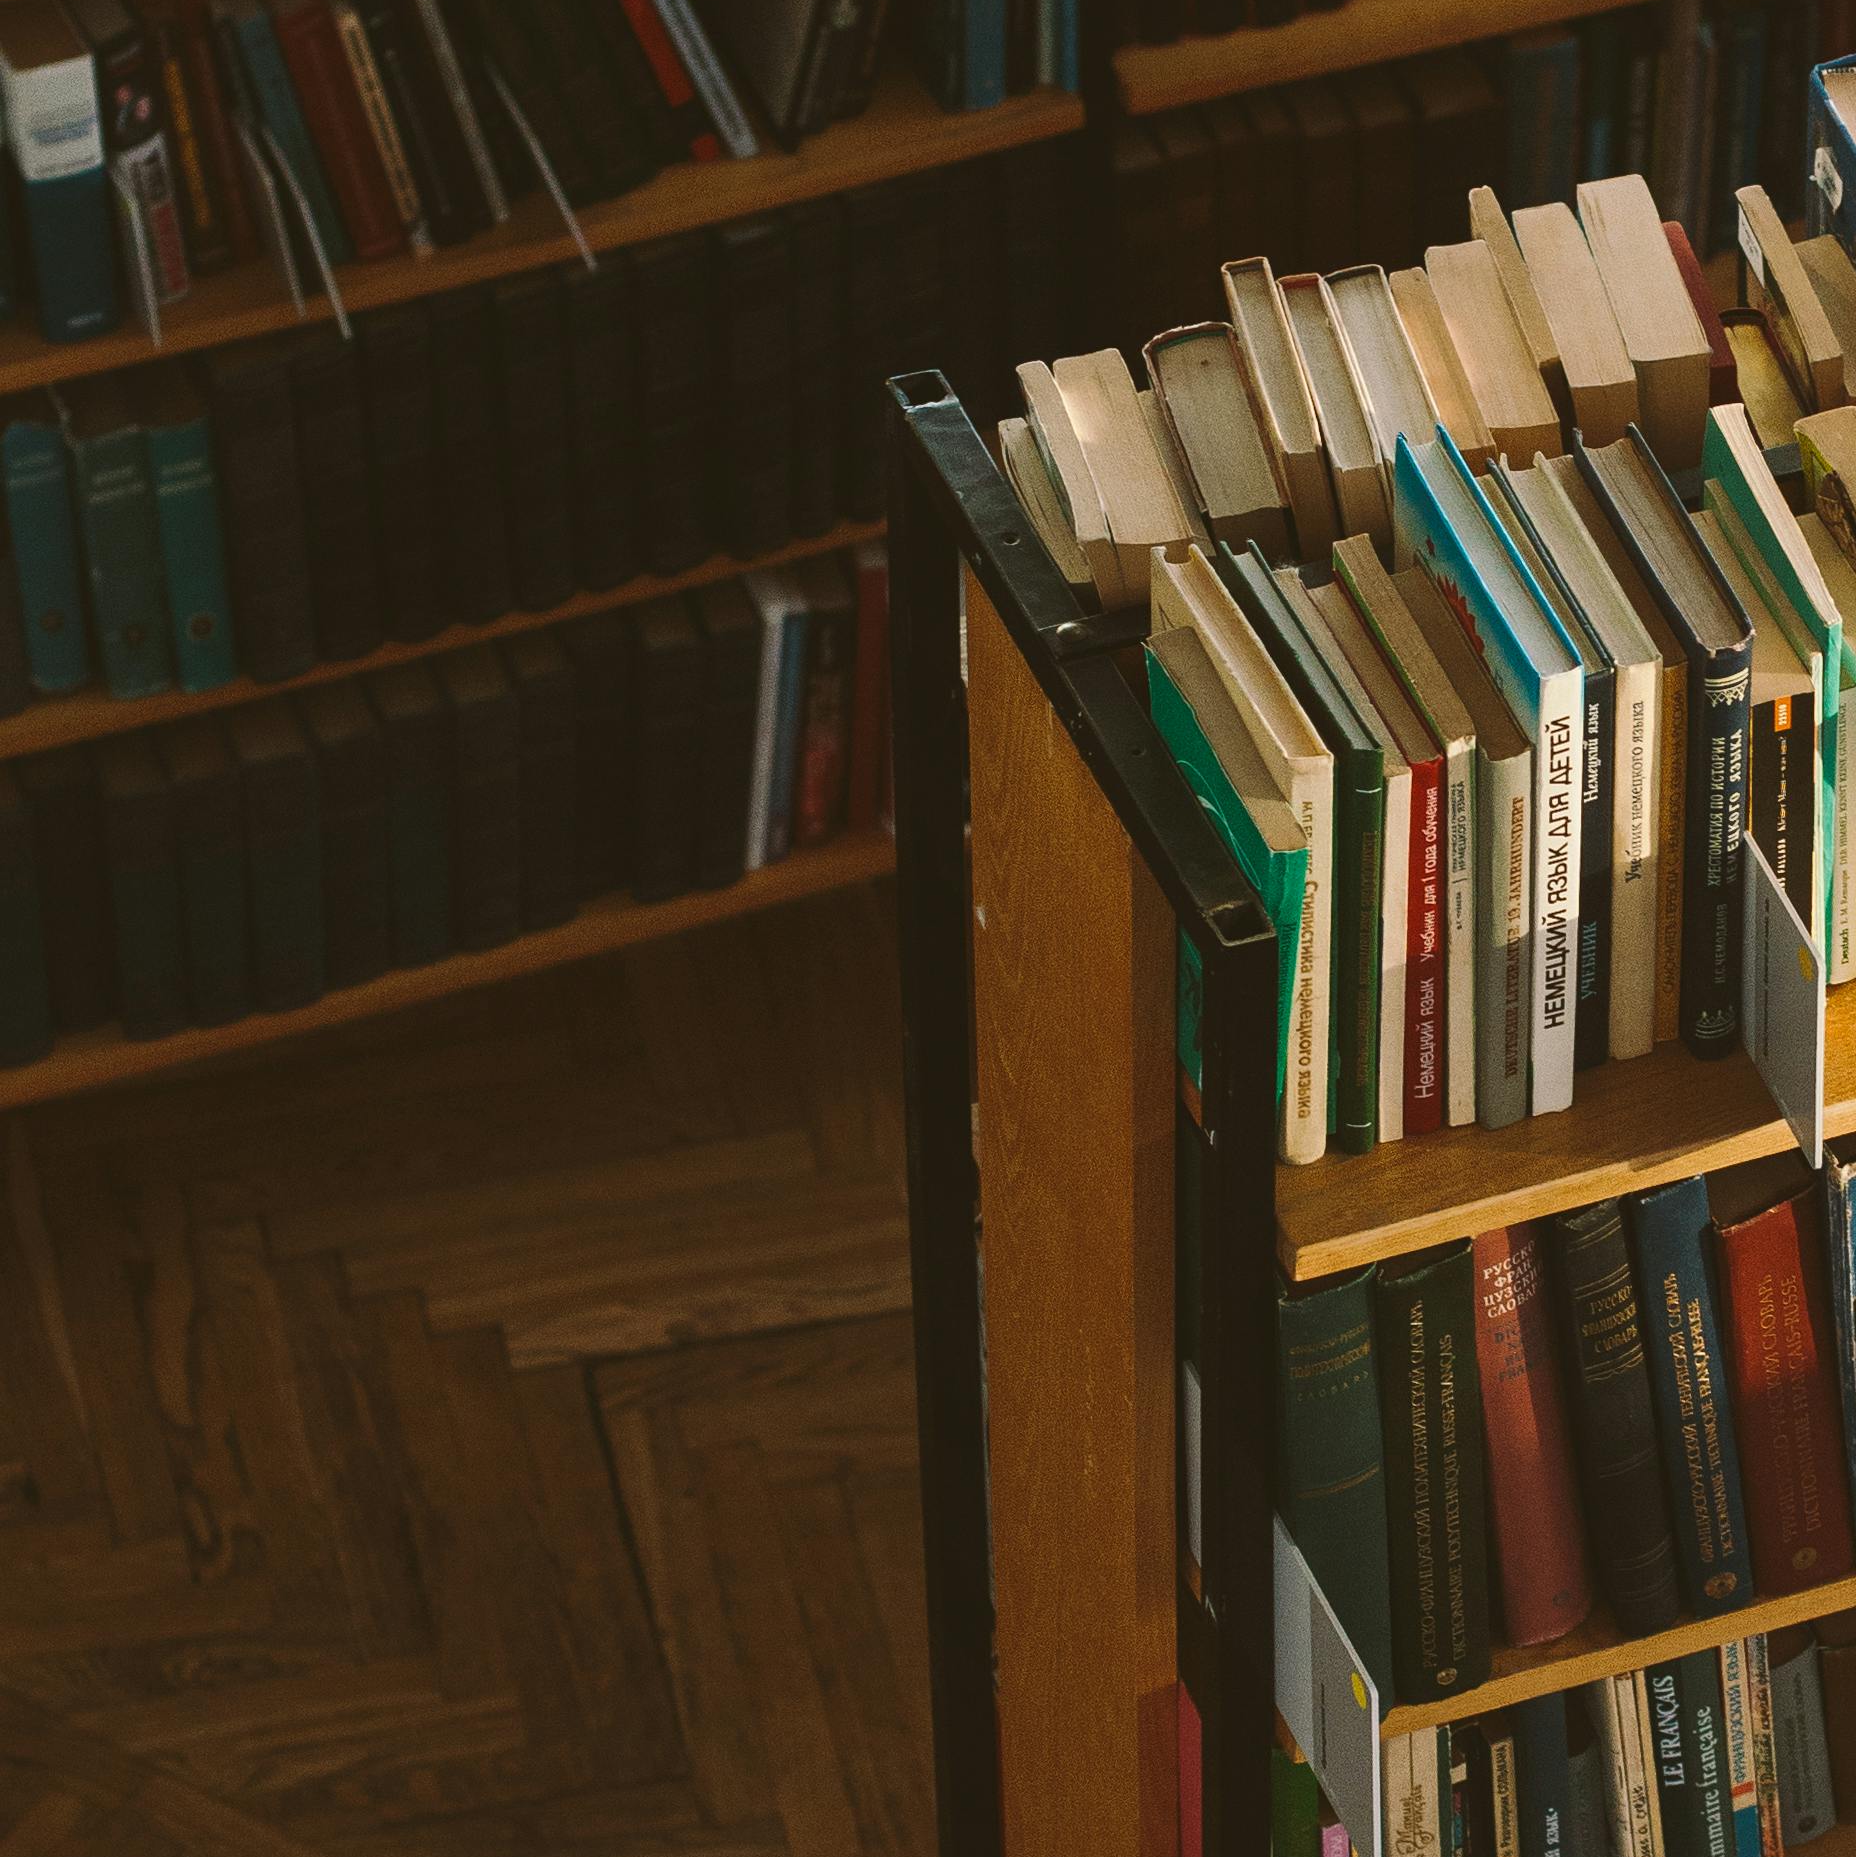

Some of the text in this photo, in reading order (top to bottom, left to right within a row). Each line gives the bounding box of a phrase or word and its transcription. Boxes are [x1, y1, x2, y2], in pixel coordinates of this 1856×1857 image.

[1582, 702, 1602, 804] Немецкий язык
[1728, 728, 1742, 783] ЯЗЫКА
[1422, 787, 1438, 842] обучения
[1457, 781, 1466, 813] ЯЗЫКА
[1624, 700, 1646, 883] Учебник немецкого языка
[1707, 737, 1726, 886] ХРЕСТОМАТИЯ ПО ИСТОРИИ
[1424, 844, 1438, 873] года
[1510, 796, 1525, 900] JAHRHUNDERT
[1541, 715, 1572, 1029] НЕМЕЦКИЙ ЯЗЫК ДЛЯ ДЕТЕЙ
[1424, 884, 1437, 905] для
[1420, 911, 1436, 962] Учебник
[1581, 921, 1598, 1000] УЧЕБНИК
[1841, 928, 1850, 964] Deutsch
[1296, 978, 1312, 1066] немецкого
[1420, 977, 1434, 1016] язык
[1413, 1020, 1436, 1099] Немецкий
[1505, 1007, 1519, 1076] DEUTSCHE
[1298, 1070, 1310, 1118] языка
[1407, 1299, 1426, 1364] СЛОВАРЬ
[1663, 1273, 1688, 1328] СЛОВАРЬ
[1758, 1273, 1776, 1351] СЛОВАРЬ
[1652, 1674, 1686, 1786] LE FRANÇAIS
[1691, 1706, 1718, 1787] française
